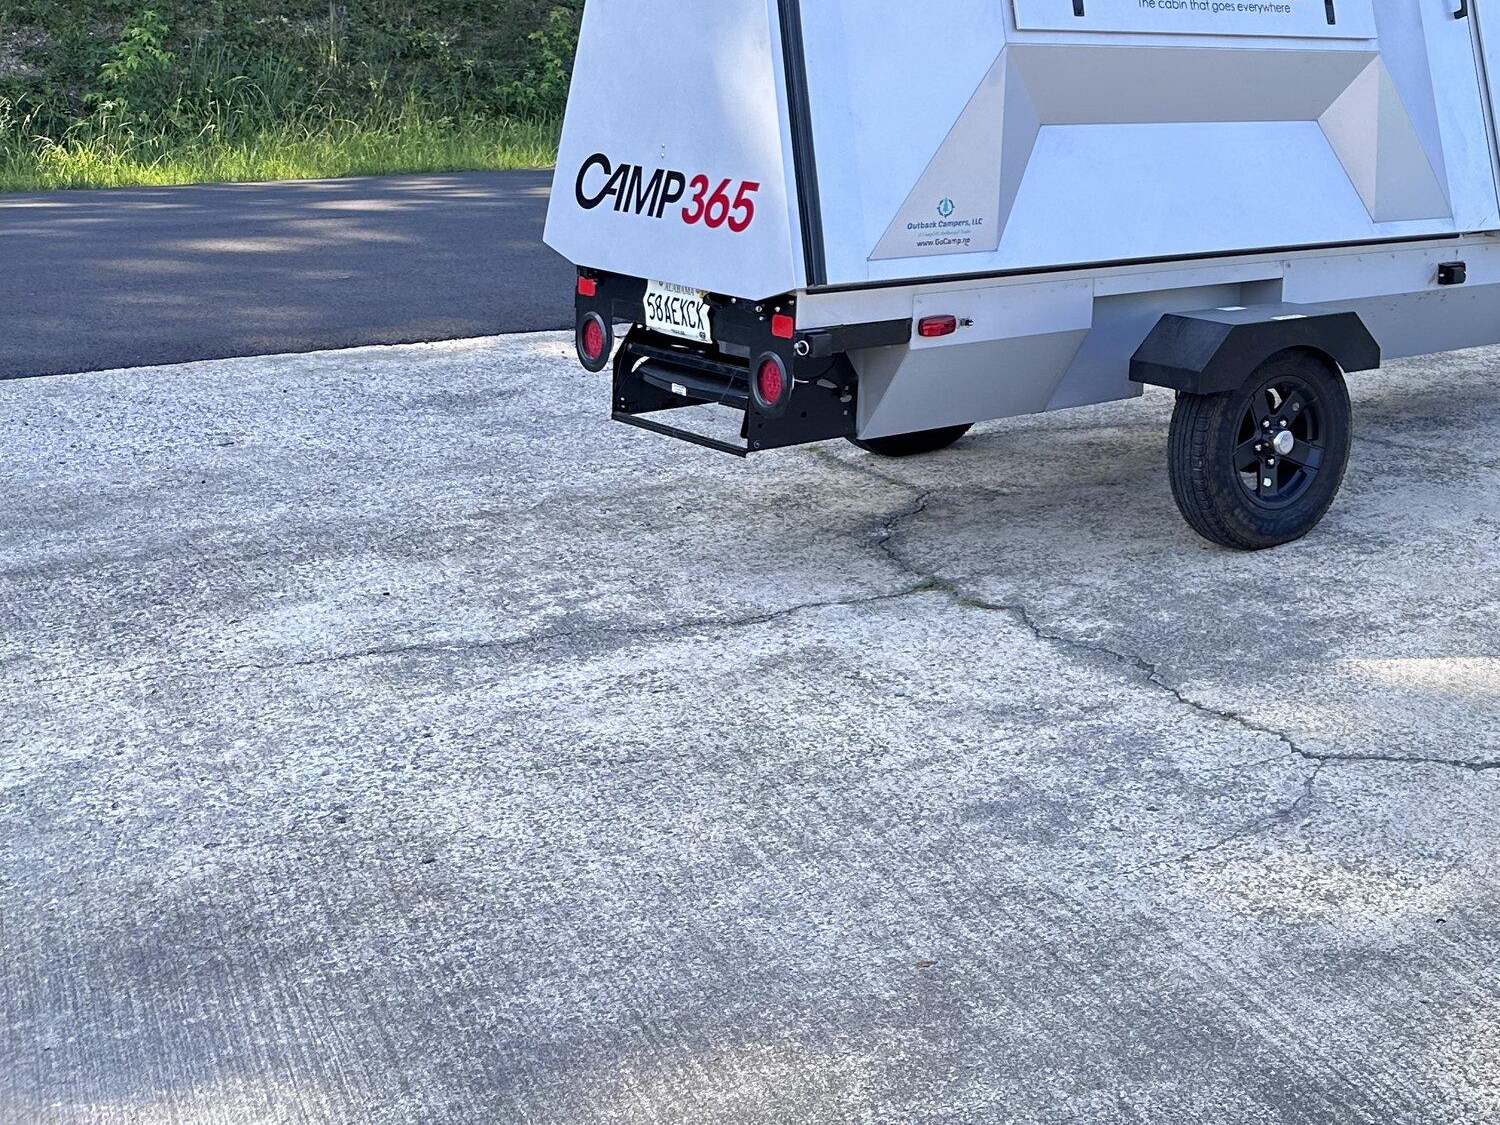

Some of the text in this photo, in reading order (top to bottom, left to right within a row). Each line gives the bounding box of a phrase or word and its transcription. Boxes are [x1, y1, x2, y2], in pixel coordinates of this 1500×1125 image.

[1158, 0, 1188, 9] cabin
[1190, 0, 1210, 11] that
[1212, 2, 1235, 14] goes
[1237, 3, 1291, 14] everywhere
[575, 153, 760, 232] CAMP365
[907, 218, 983, 230] Outback Campers, LLC
[664, 283, 695, 296] ALABAMA
[646, 293, 705, 331] 58AEXCX
